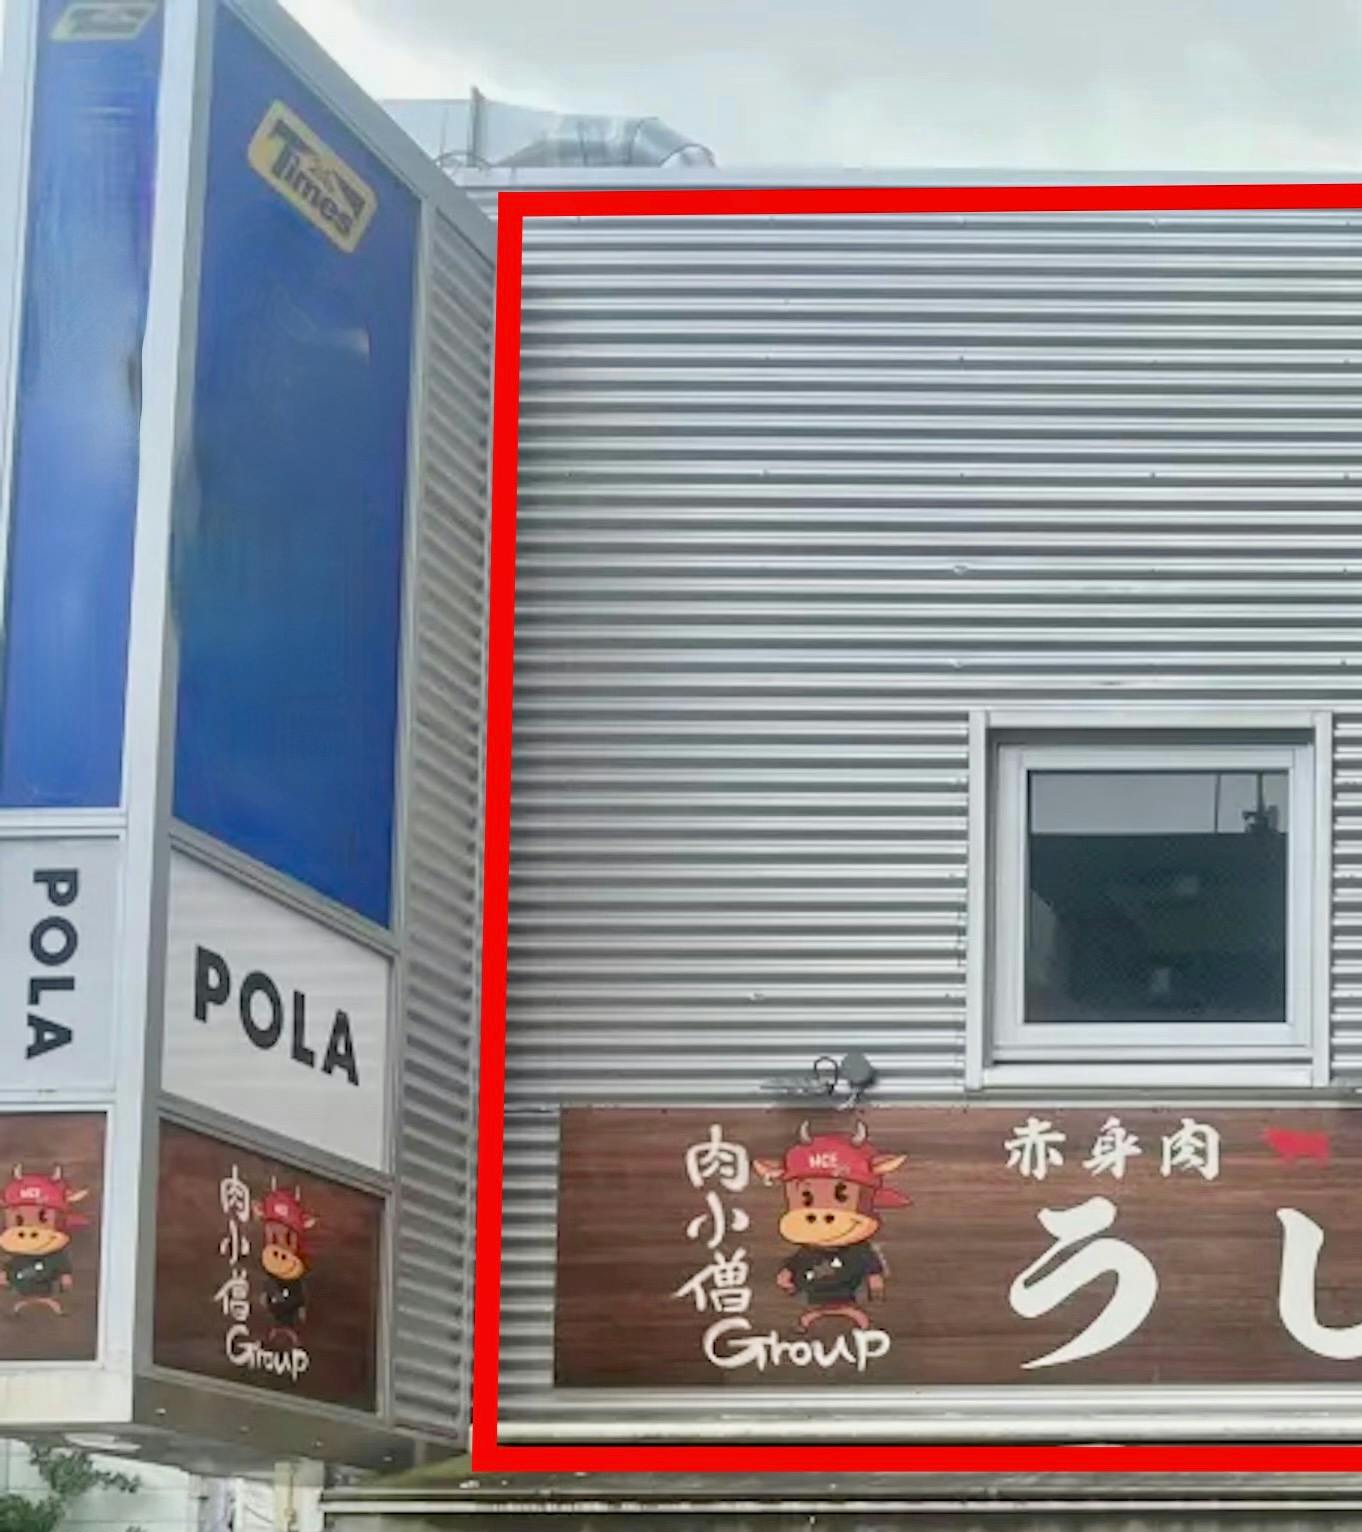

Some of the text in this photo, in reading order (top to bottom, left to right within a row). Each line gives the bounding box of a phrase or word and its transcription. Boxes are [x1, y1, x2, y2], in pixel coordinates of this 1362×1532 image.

[26, 868, 79, 1060] POLA
[194, 945, 360, 1086] POLA
[1003, 1117, 1221, 1180] 赤身肉
[214, 1164, 251, 1321] 肉小僧
[673, 1124, 752, 1315] 肉小僧
[226, 1328, 310, 1380] Group
[703, 1318, 891, 1372] Group
